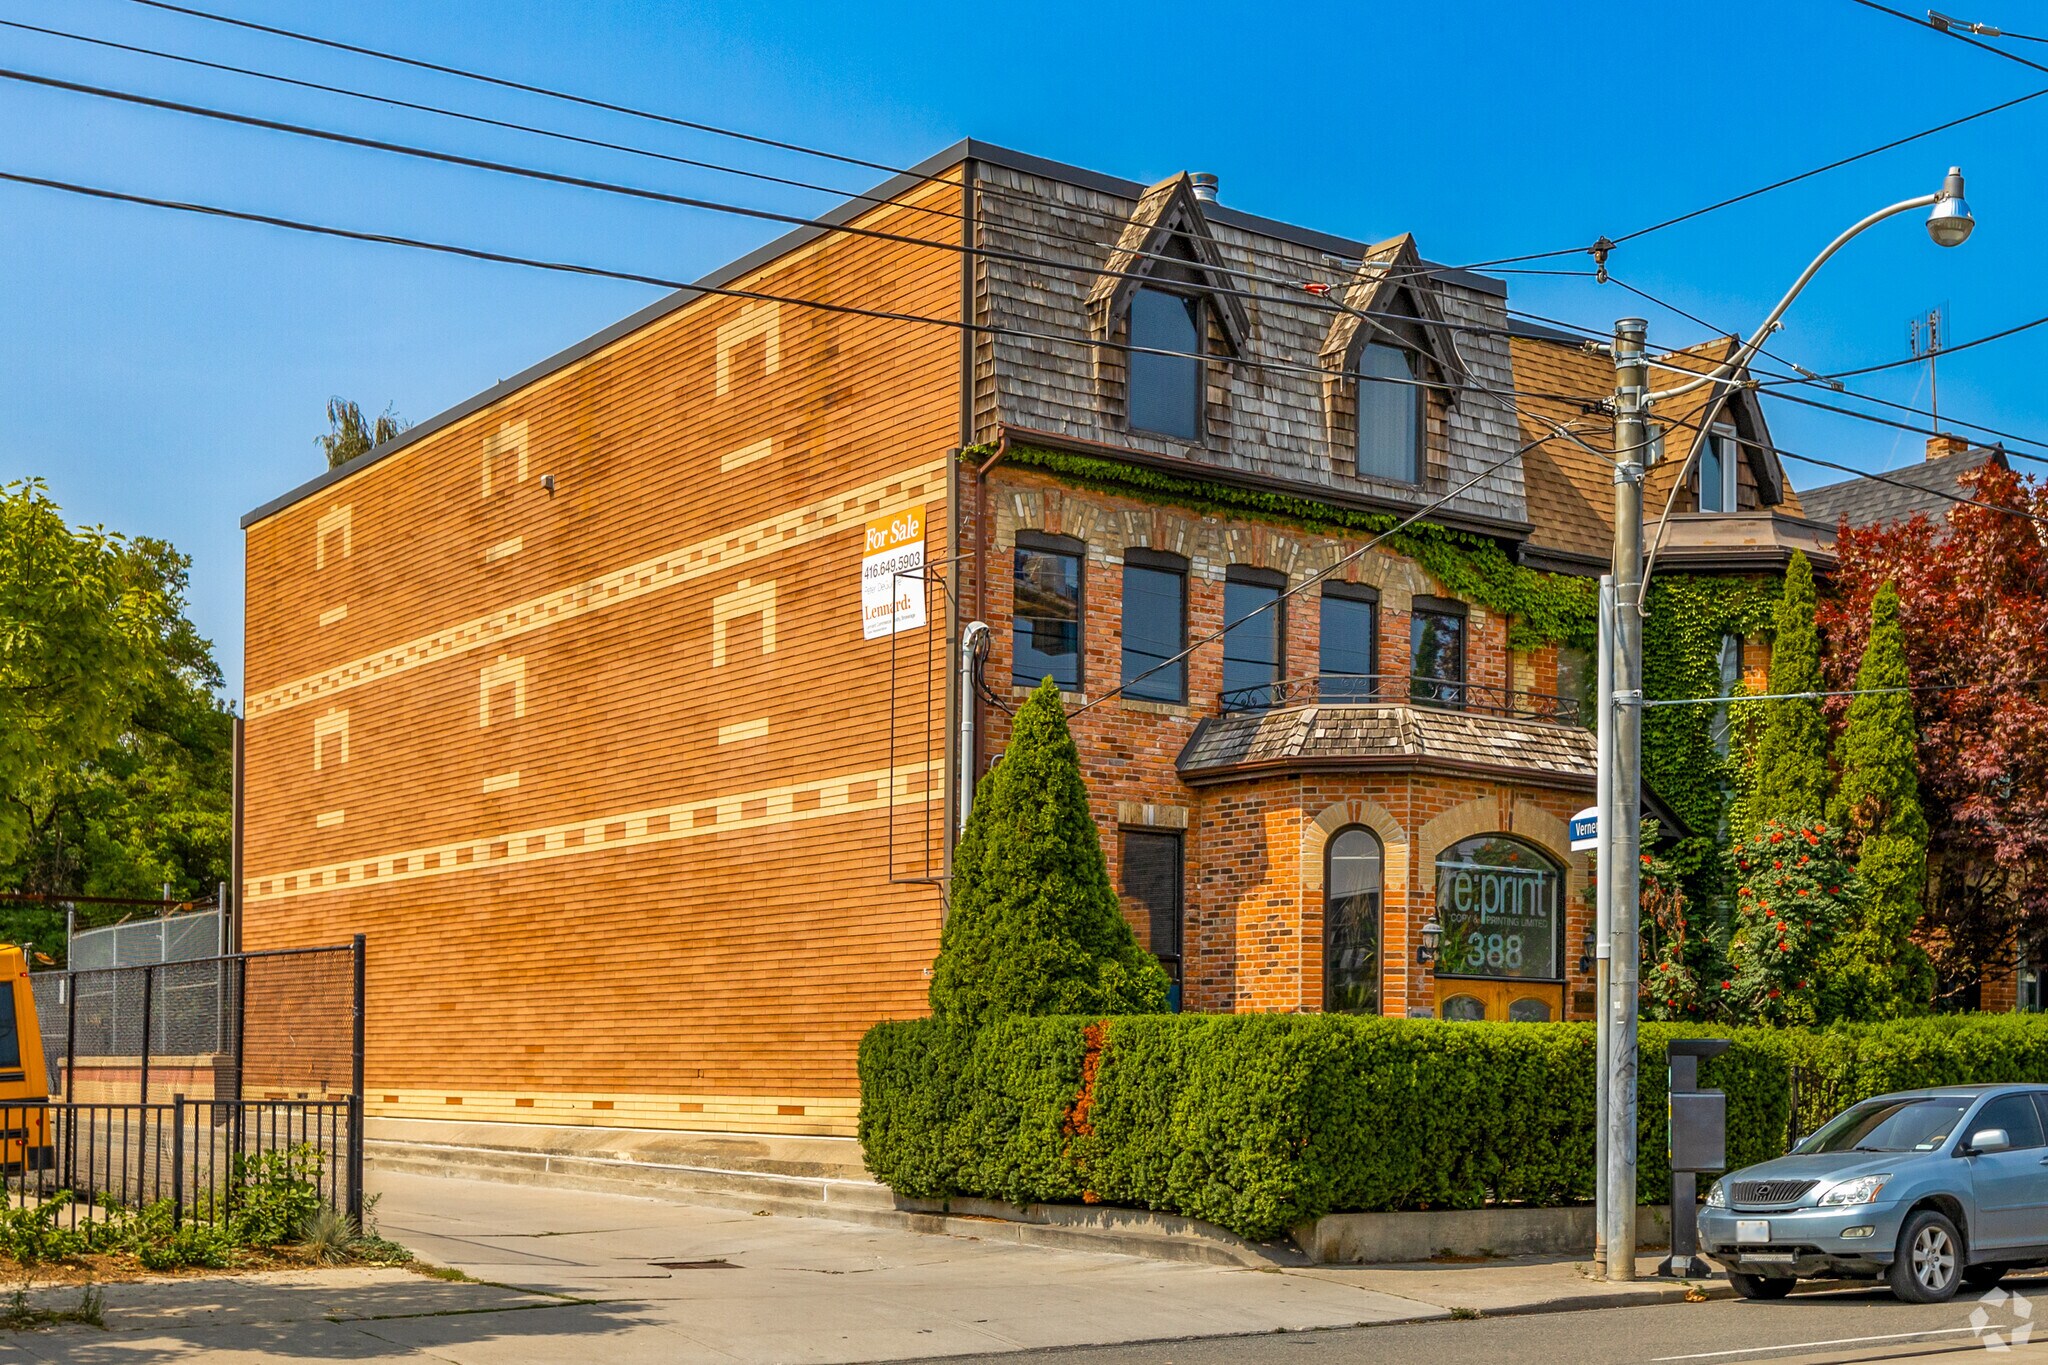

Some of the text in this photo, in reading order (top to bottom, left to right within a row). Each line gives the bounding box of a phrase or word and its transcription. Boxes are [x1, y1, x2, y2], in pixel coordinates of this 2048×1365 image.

[866, 514, 919, 551] For Sale
[865, 551, 920, 580] 416.649.5903
[1451, 913, 1472, 923] COPY
[1486, 916, 1519, 926] PRINTING
[1521, 919, 1548, 928] LIMITED
[1468, 932, 1522, 967] 388
